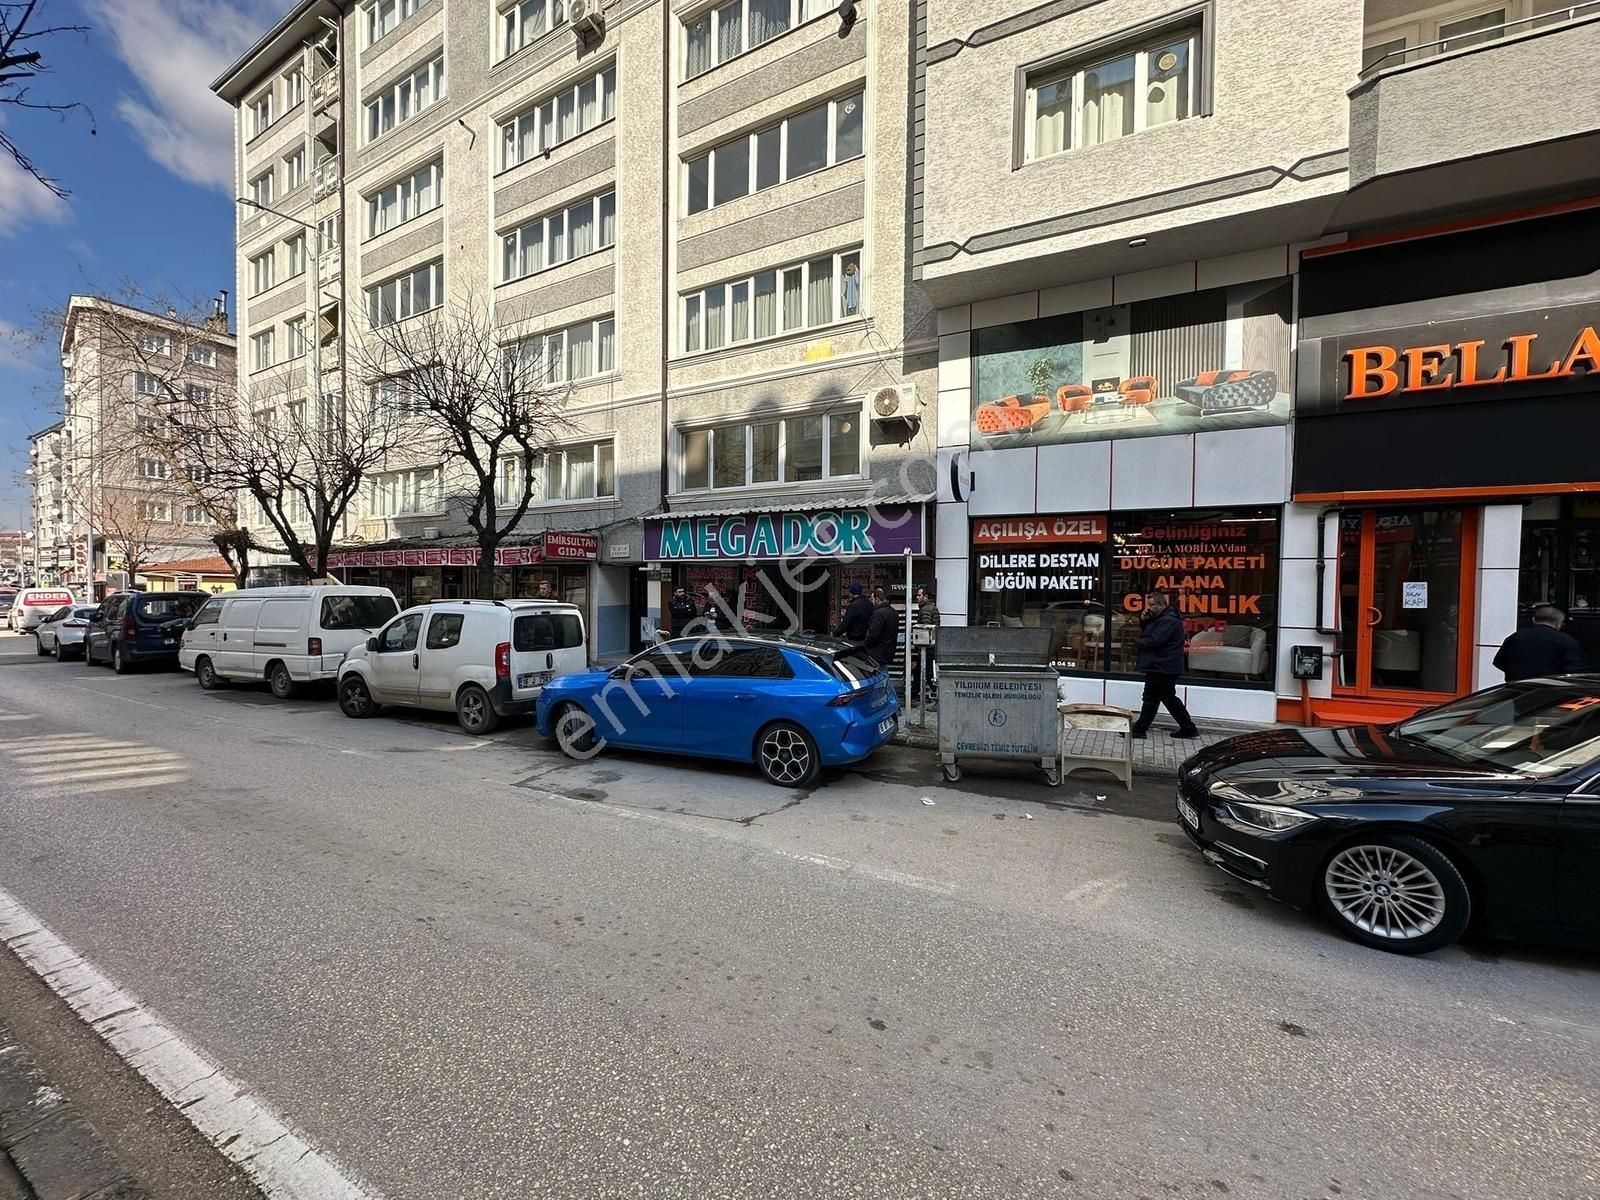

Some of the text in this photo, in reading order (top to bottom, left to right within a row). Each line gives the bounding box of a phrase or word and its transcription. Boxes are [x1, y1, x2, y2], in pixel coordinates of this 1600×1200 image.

[1343, 326, 1600, 400] BELLA
[659, 509, 876, 558] MEGADOR
[978, 518, 1102, 541] AÇILIŞA ÖZEL
[547, 534, 597, 548] EMİRSULTAN
[557, 546, 585, 557] GIDA
[1039, 553, 1099, 568] DESTAN
[984, 571, 1037, 590] DÜĞÜN
[1154, 575, 1225, 589] ALANA
